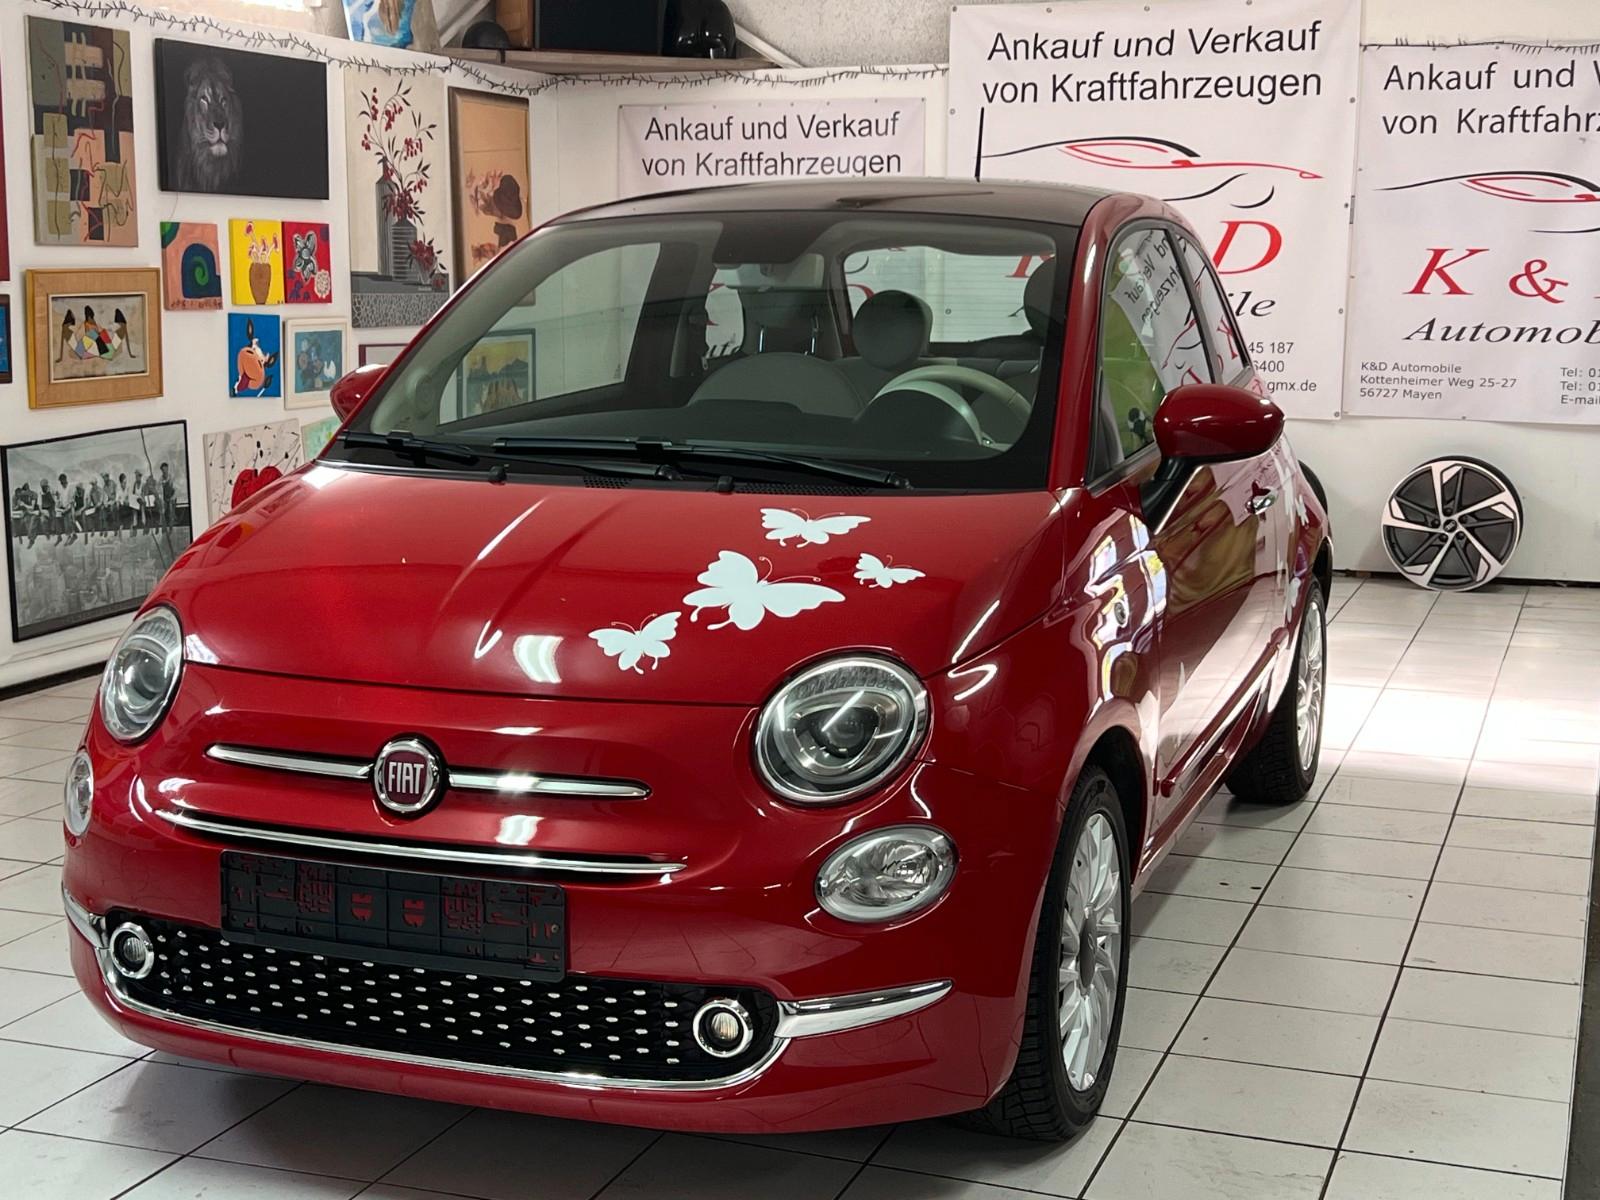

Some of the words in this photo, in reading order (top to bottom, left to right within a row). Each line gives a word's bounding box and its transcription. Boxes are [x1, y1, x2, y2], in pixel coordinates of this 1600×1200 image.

[988, 31, 1105, 61] Ankauf
[1113, 29, 1175, 58] und
[1188, 20, 1322, 55] Verkauf
[1383, 61, 1498, 91] Ankauf
[1513, 59, 1576, 89] und
[982, 81, 1038, 104] von
[1051, 71, 1322, 105] Kraftfahrzeugen
[644, 116, 733, 141] Ankauf
[741, 115, 788, 140] und
[796, 111, 901, 139] Verkauf
[1382, 114, 1437, 135] von
[641, 157, 686, 176] von
[695, 151, 902, 177] Kraftfahrzeugen
[1403, 248, 1490, 296] K
[1508, 258, 1569, 304] &
[1269, 341, 1295, 354] 187
[1360, 361, 1388, 372] K&D
[1391, 362, 1463, 374] Automobile
[1560, 367, 1583, 378] Tel:
[1360, 375, 1444, 387] Kottenheimer
[1447, 377, 1475, 389] Weg
[1479, 378, 1517, 389] 25-27
[1560, 381, 1583, 391] Tel:
[1359, 387, 1399, 399] 56727
[1402, 389, 1443, 401] Mayen
[388, 762, 424, 794] FIAT
